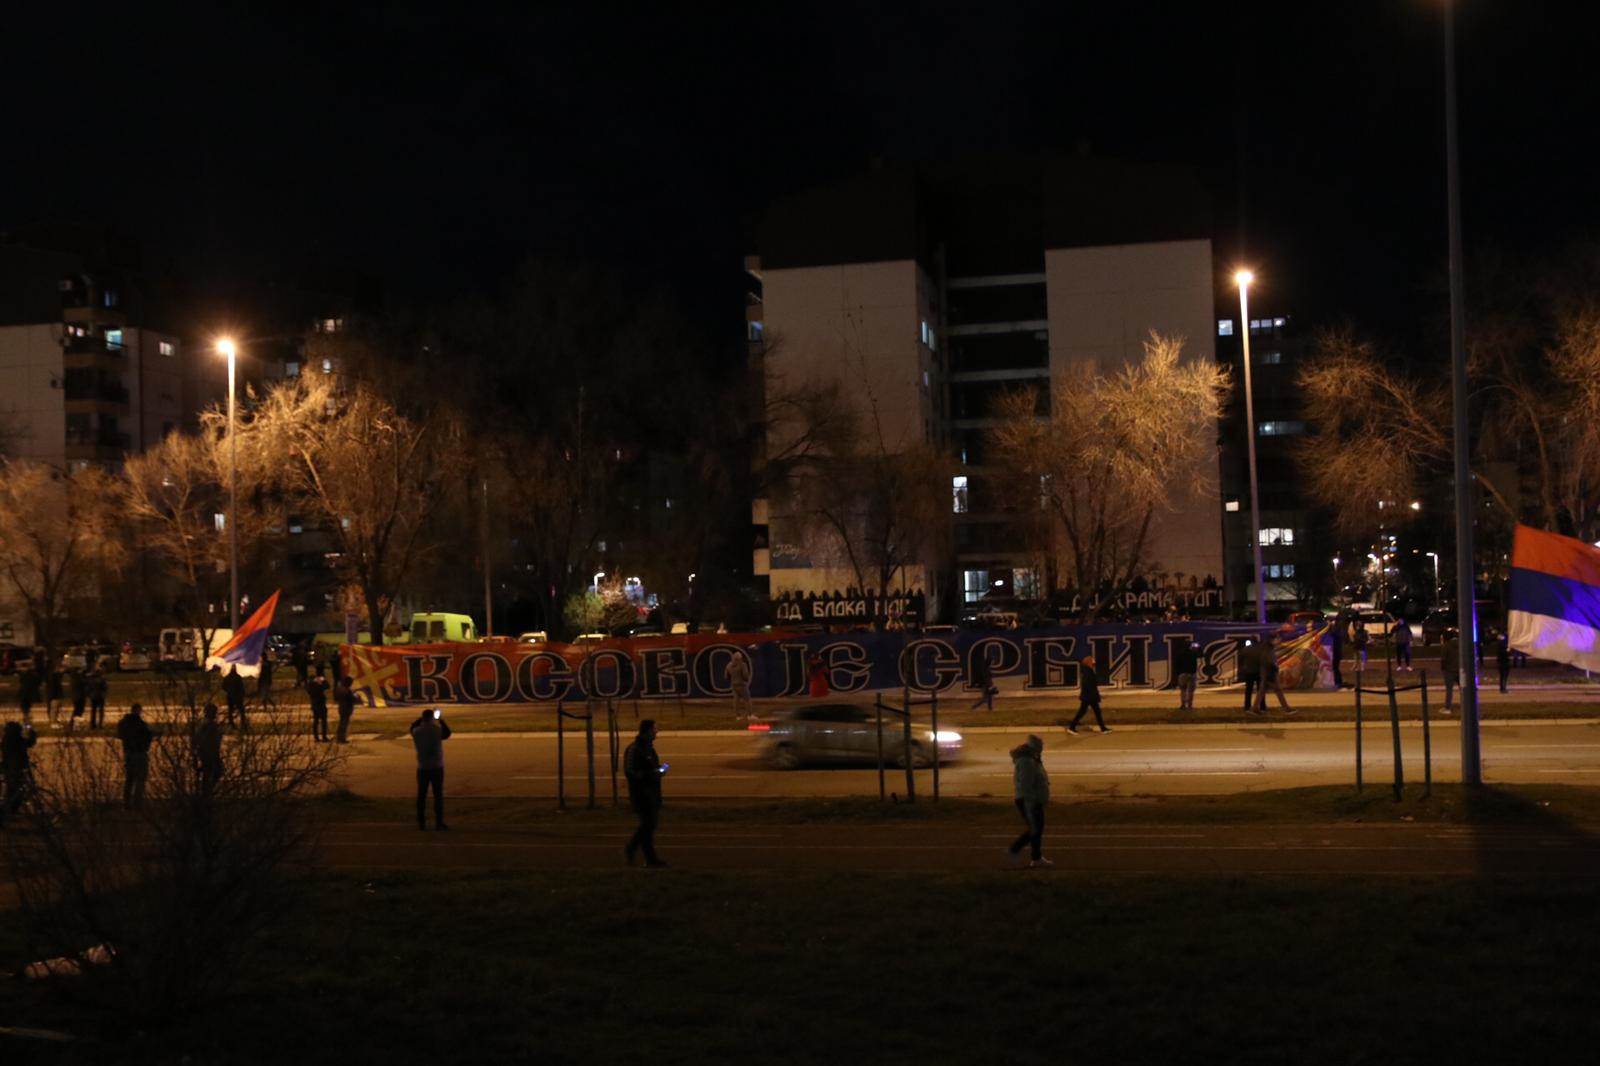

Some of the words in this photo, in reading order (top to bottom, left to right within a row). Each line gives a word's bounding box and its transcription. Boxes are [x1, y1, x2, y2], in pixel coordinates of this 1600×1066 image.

[812, 600, 866, 618] БЛОКА
[402, 643, 752, 702] КОСОВО
[898, 633, 1261, 693] СРБИЈА
